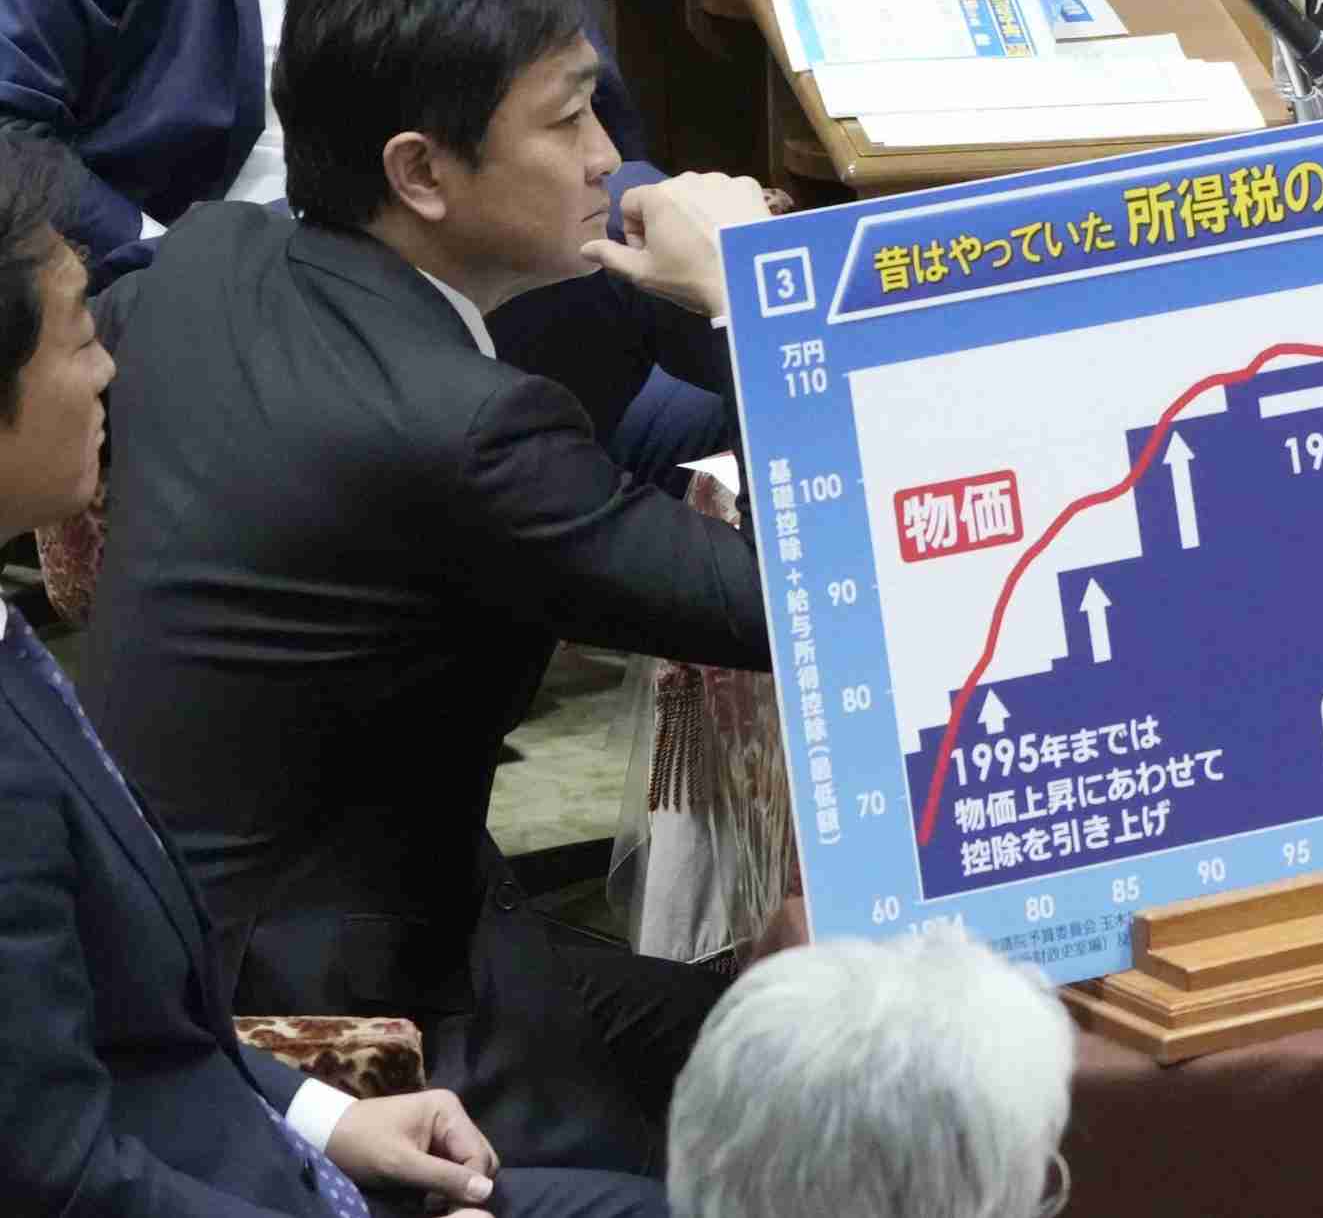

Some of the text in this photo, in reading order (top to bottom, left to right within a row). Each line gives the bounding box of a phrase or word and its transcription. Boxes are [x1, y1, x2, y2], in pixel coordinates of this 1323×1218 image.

[874, 211, 1116, 293] 昔はやっていた
[775, 268, 796, 300] 3
[781, 339, 826, 368] 万円
[784, 369, 827, 398] 110
[800, 473, 843, 503] 100
[903, 480, 1015, 553] 物価
[827, 579, 857, 606] 90
[842, 685, 872, 713] 80
[950, 714, 1161, 786] 1995年までは
[856, 790, 886, 818] 70
[954, 748, 1225, 834] 物価上昇にあわせて
[960, 800, 1171, 877] 控除を引き上げ
[1282, 838, 1311, 867] 95
[1197, 857, 1226, 884] 90
[1111, 876, 1140, 903] 85
[872, 895, 900, 924] 60
[1025, 894, 1055, 922] 80
